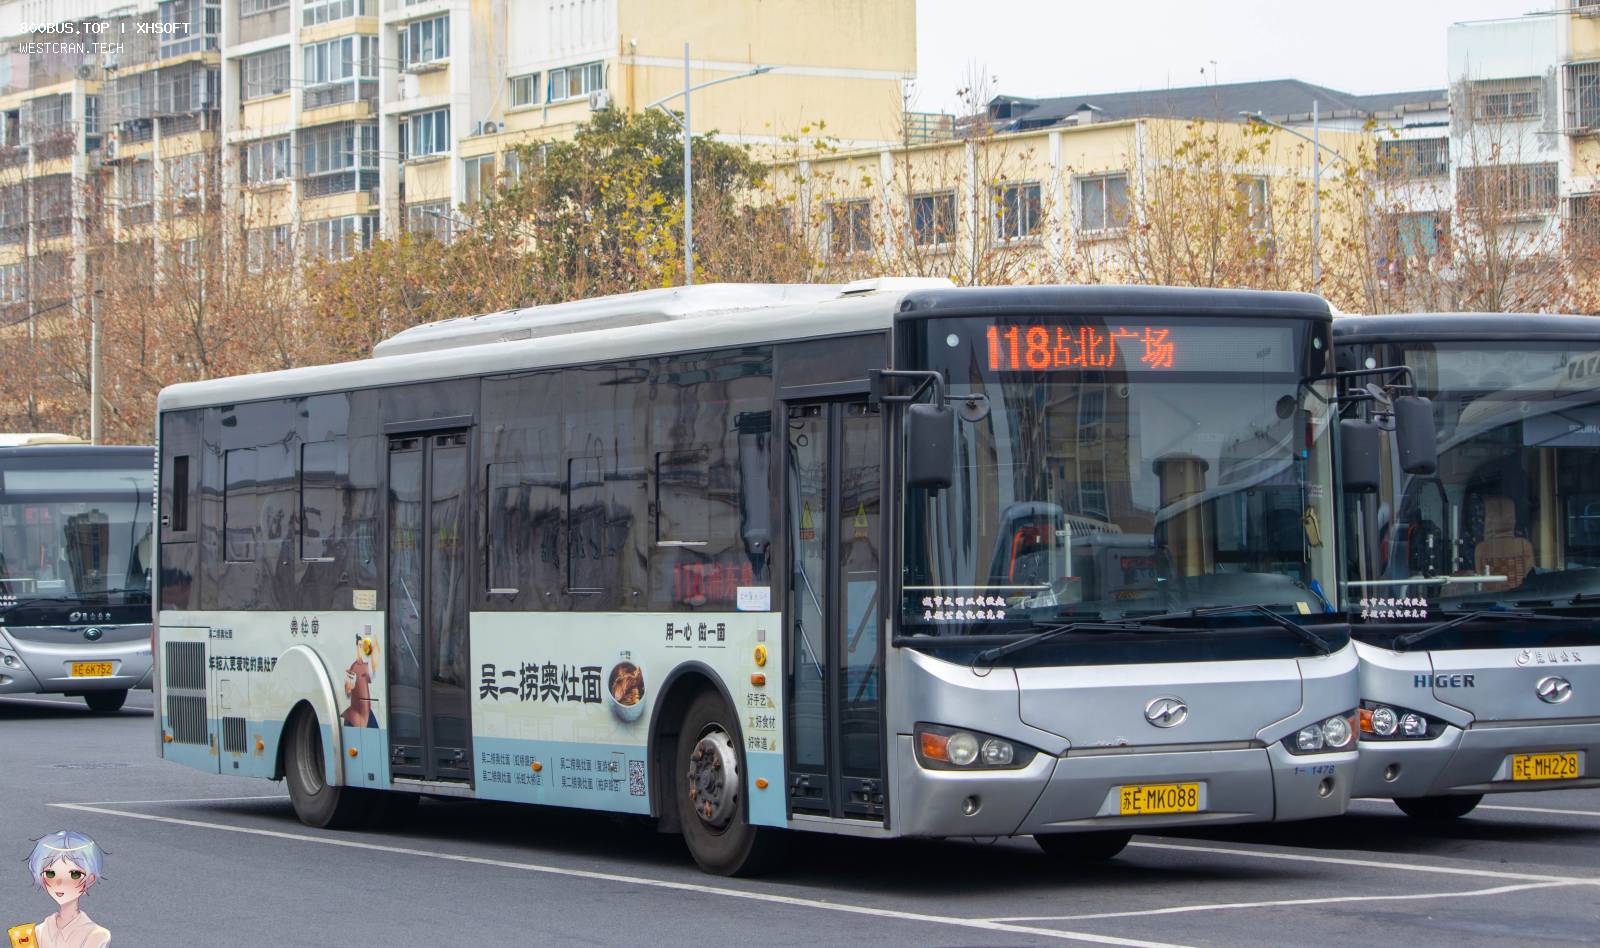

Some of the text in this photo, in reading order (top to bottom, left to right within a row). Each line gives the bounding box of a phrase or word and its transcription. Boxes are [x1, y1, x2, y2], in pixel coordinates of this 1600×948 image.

[987, 326, 1050, 369] 118
[666, 622, 692, 641] 用一心
[480, 661, 603, 704] 吴二捞奥灶面
[1414, 674, 1476, 688] HIGER
